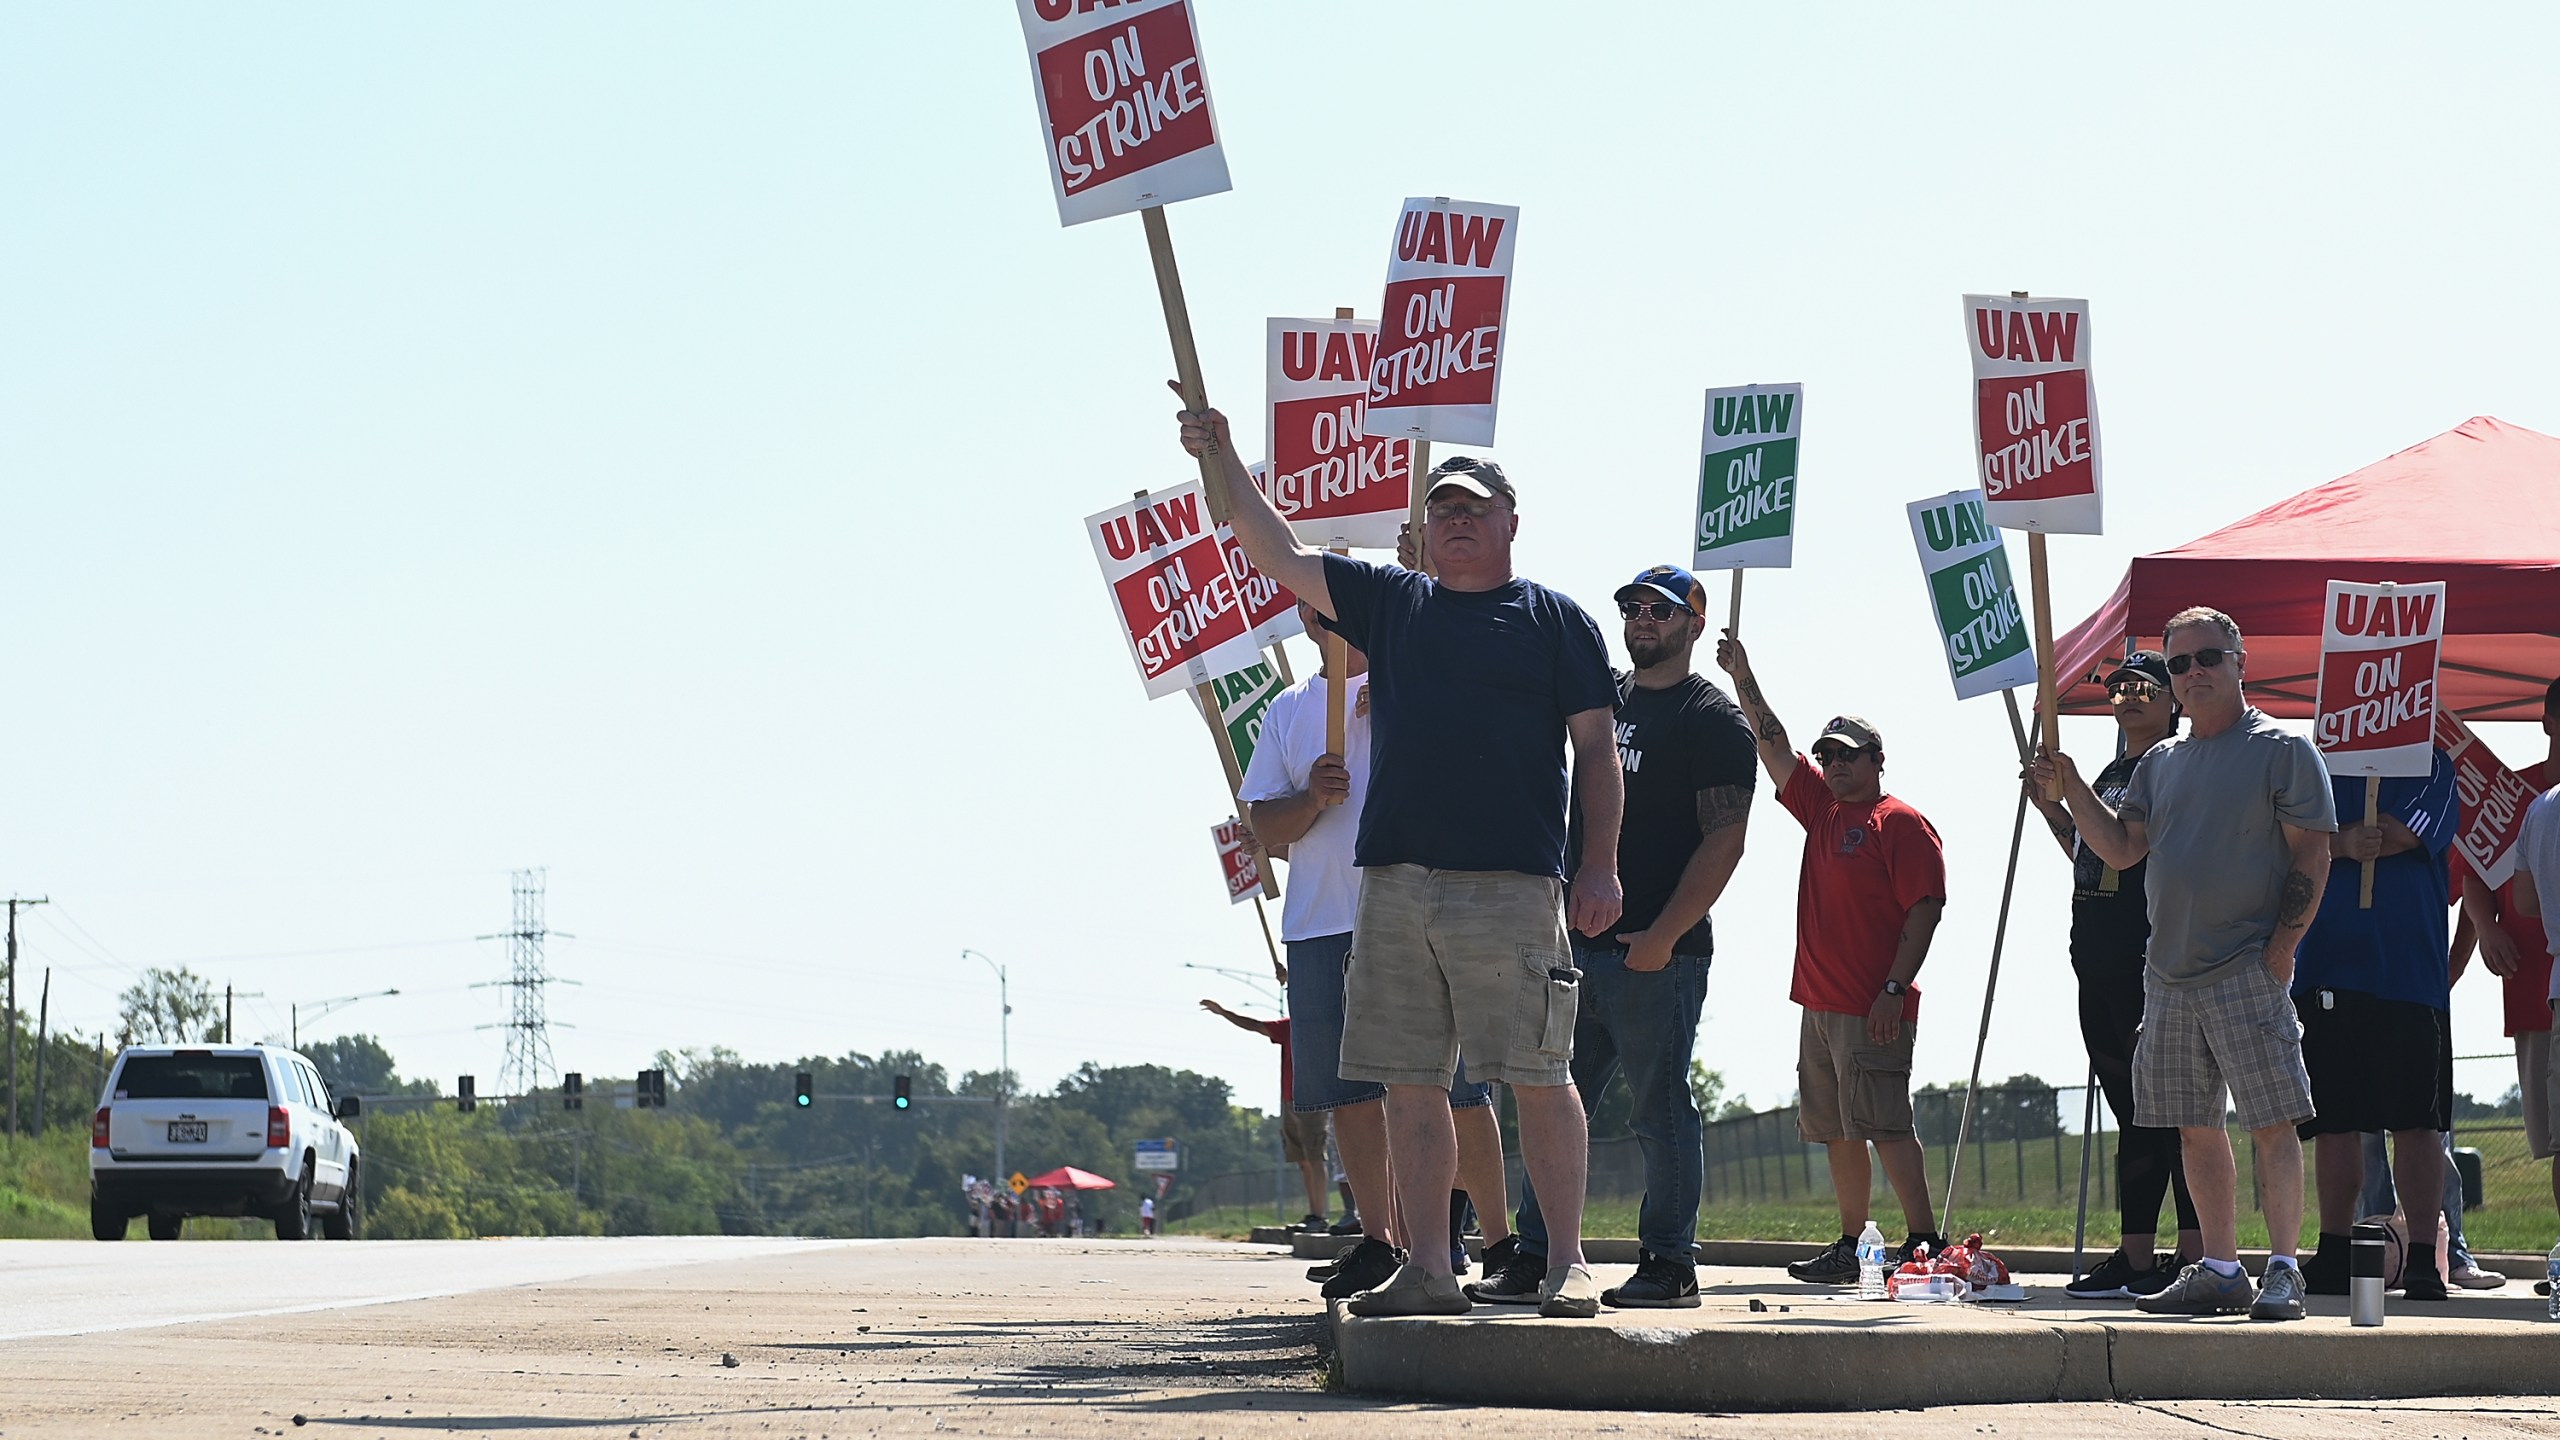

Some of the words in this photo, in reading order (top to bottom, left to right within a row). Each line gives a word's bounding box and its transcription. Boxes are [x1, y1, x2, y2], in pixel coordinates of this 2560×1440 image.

[1084, 25, 1145, 101] ON
[1058, 56, 1204, 189] STRIKE
[1397, 210, 1505, 269] UAW
[1404, 283, 1455, 339] ON
[1975, 308, 2079, 362] UAW
[1370, 326, 1498, 402] STRIKE
[1312, 399, 1364, 455] ON
[1713, 393, 1795, 437] UAW
[2005, 381, 2046, 436] ON
[1276, 437, 1408, 516] STRIKE
[1727, 447, 1762, 493] ON
[1984, 417, 2091, 496] STRIKE
[1100, 492, 1201, 562] UAW
[1700, 475, 1794, 547] STRIKE
[1147, 556, 1191, 614] ON
[1963, 557, 1998, 610] ON
[1138, 572, 1237, 674] STRIKE
[1949, 585, 2020, 672] STRIKE
[2334, 592, 2436, 638] UAW
[2355, 651, 2401, 697] ON
[2318, 678, 2432, 748] STRIKE
[1618, 746, 1643, 773] ON
[2456, 756, 2488, 808] ON
[2464, 765, 2525, 866] STRIKE
